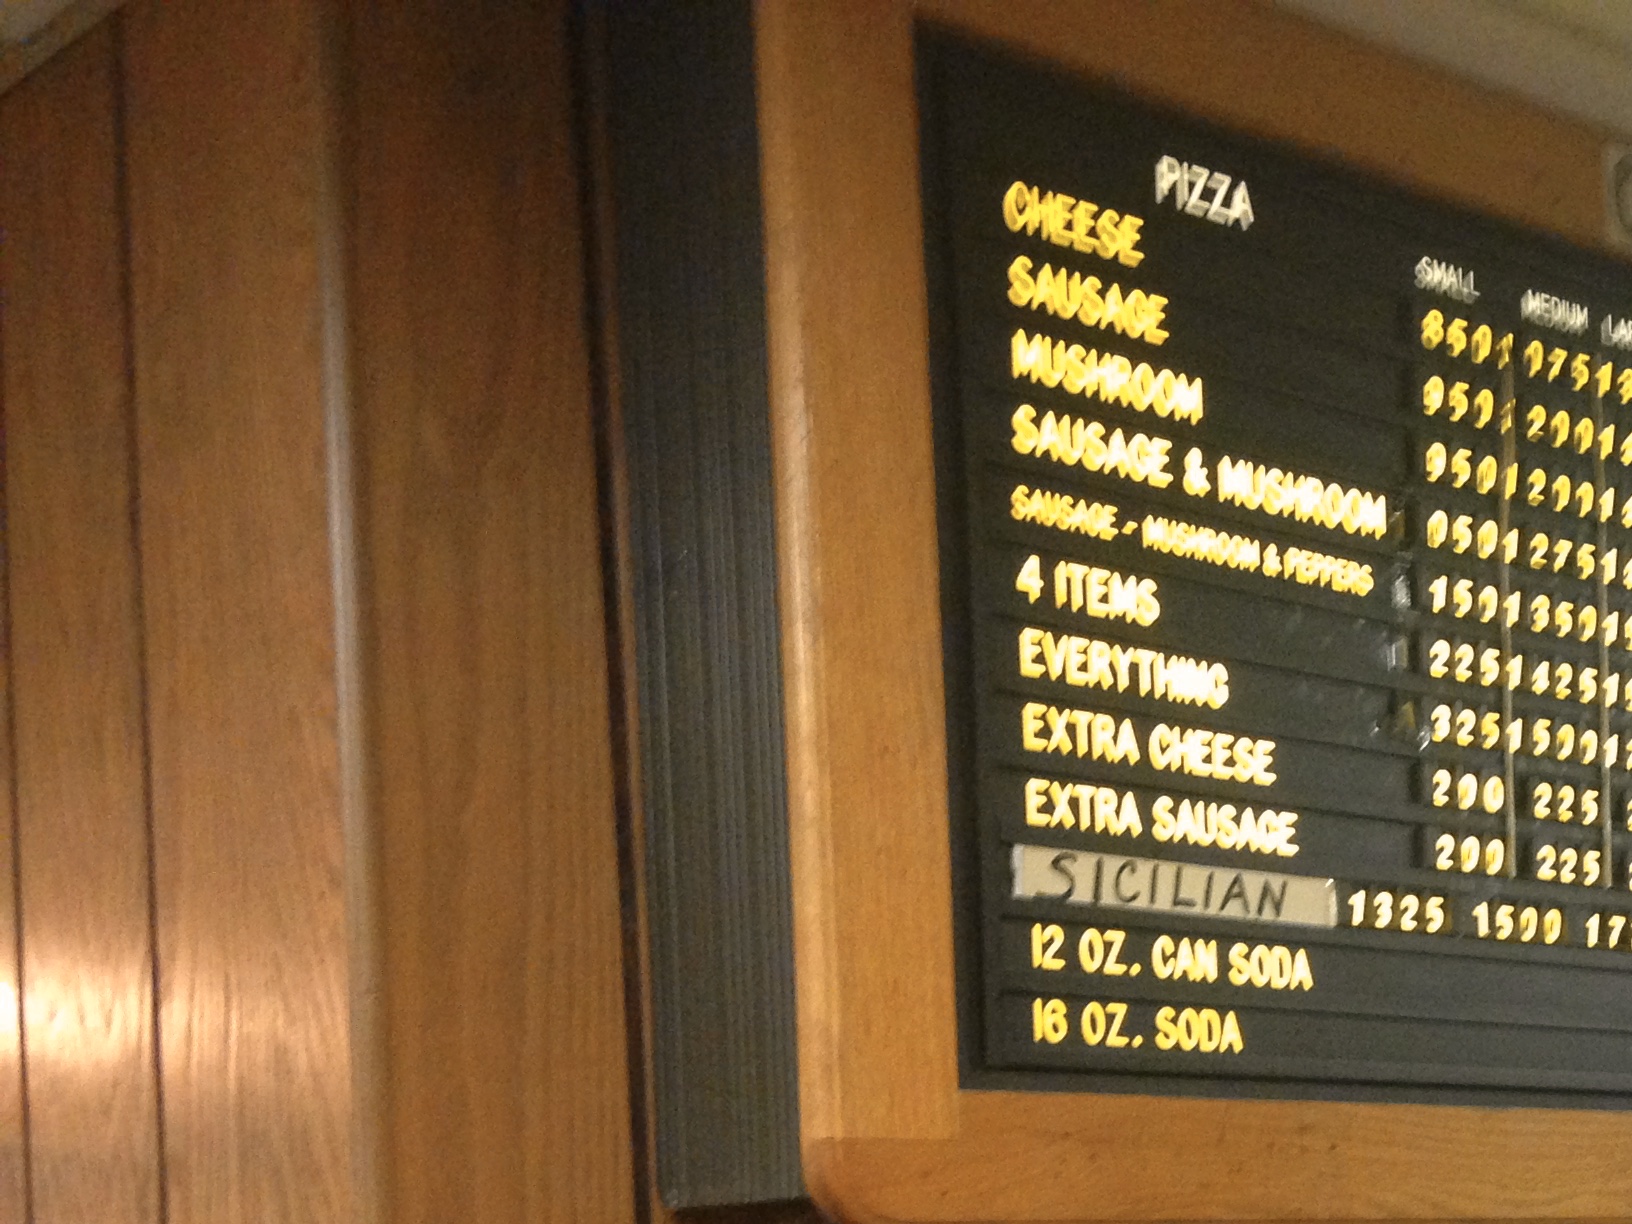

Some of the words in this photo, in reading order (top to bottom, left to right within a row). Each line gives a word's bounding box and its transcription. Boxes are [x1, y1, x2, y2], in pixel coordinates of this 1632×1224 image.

[1155, 155, 1254, 231] PIZZA
[1003, 181, 1144, 268] CHEESE
[1420, 308, 1493, 364] 850
[1415, 256, 1480, 304] SMALL
[1520, 289, 1589, 335] MEDIUM
[1008, 256, 1169, 345] SAUSAGE
[1423, 375, 1494, 429] 950
[1011, 329, 1203, 425] MUSHROOM
[1425, 442, 1497, 495] 950
[1012, 404, 1173, 488] SAUSAGE
[1183, 447, 1211, 497] &
[1217, 455, 1386, 539] MUSHROOM
[1016, 554, 1044, 604] 4
[1055, 560, 1160, 627] ITEMS
[1263, 543, 1283, 578] &
[1284, 547, 1374, 597] PEPPERS
[1019, 627, 1230, 710] EVERYTHING
[1022, 702, 1141, 766] EXTRA
[1149, 723, 1277, 786] CHEESE
[1432, 769, 1505, 814] 200
[1534, 782, 1599, 826] 225
[1025, 777, 1143, 838] EXTRA
[1152, 795, 1299, 857] SAUSAGE
[1435, 834, 1505, 875] 200
[1536, 844, 1601, 886] 225
[1037, 852, 1289, 918] SICILIAN
[1349, 890, 1445, 934] 1325
[1472, 901, 1563, 945] 1500
[1031, 923, 1066, 971] 12
[1079, 928, 1141, 977] OZ.
[1152, 935, 1218, 984] CAN
[1229, 942, 1314, 991] SODA
[1032, 998, 1068, 1045] 16
[1080, 1001, 1143, 1049] OZ.
[1155, 1006, 1244, 1055] SODA
